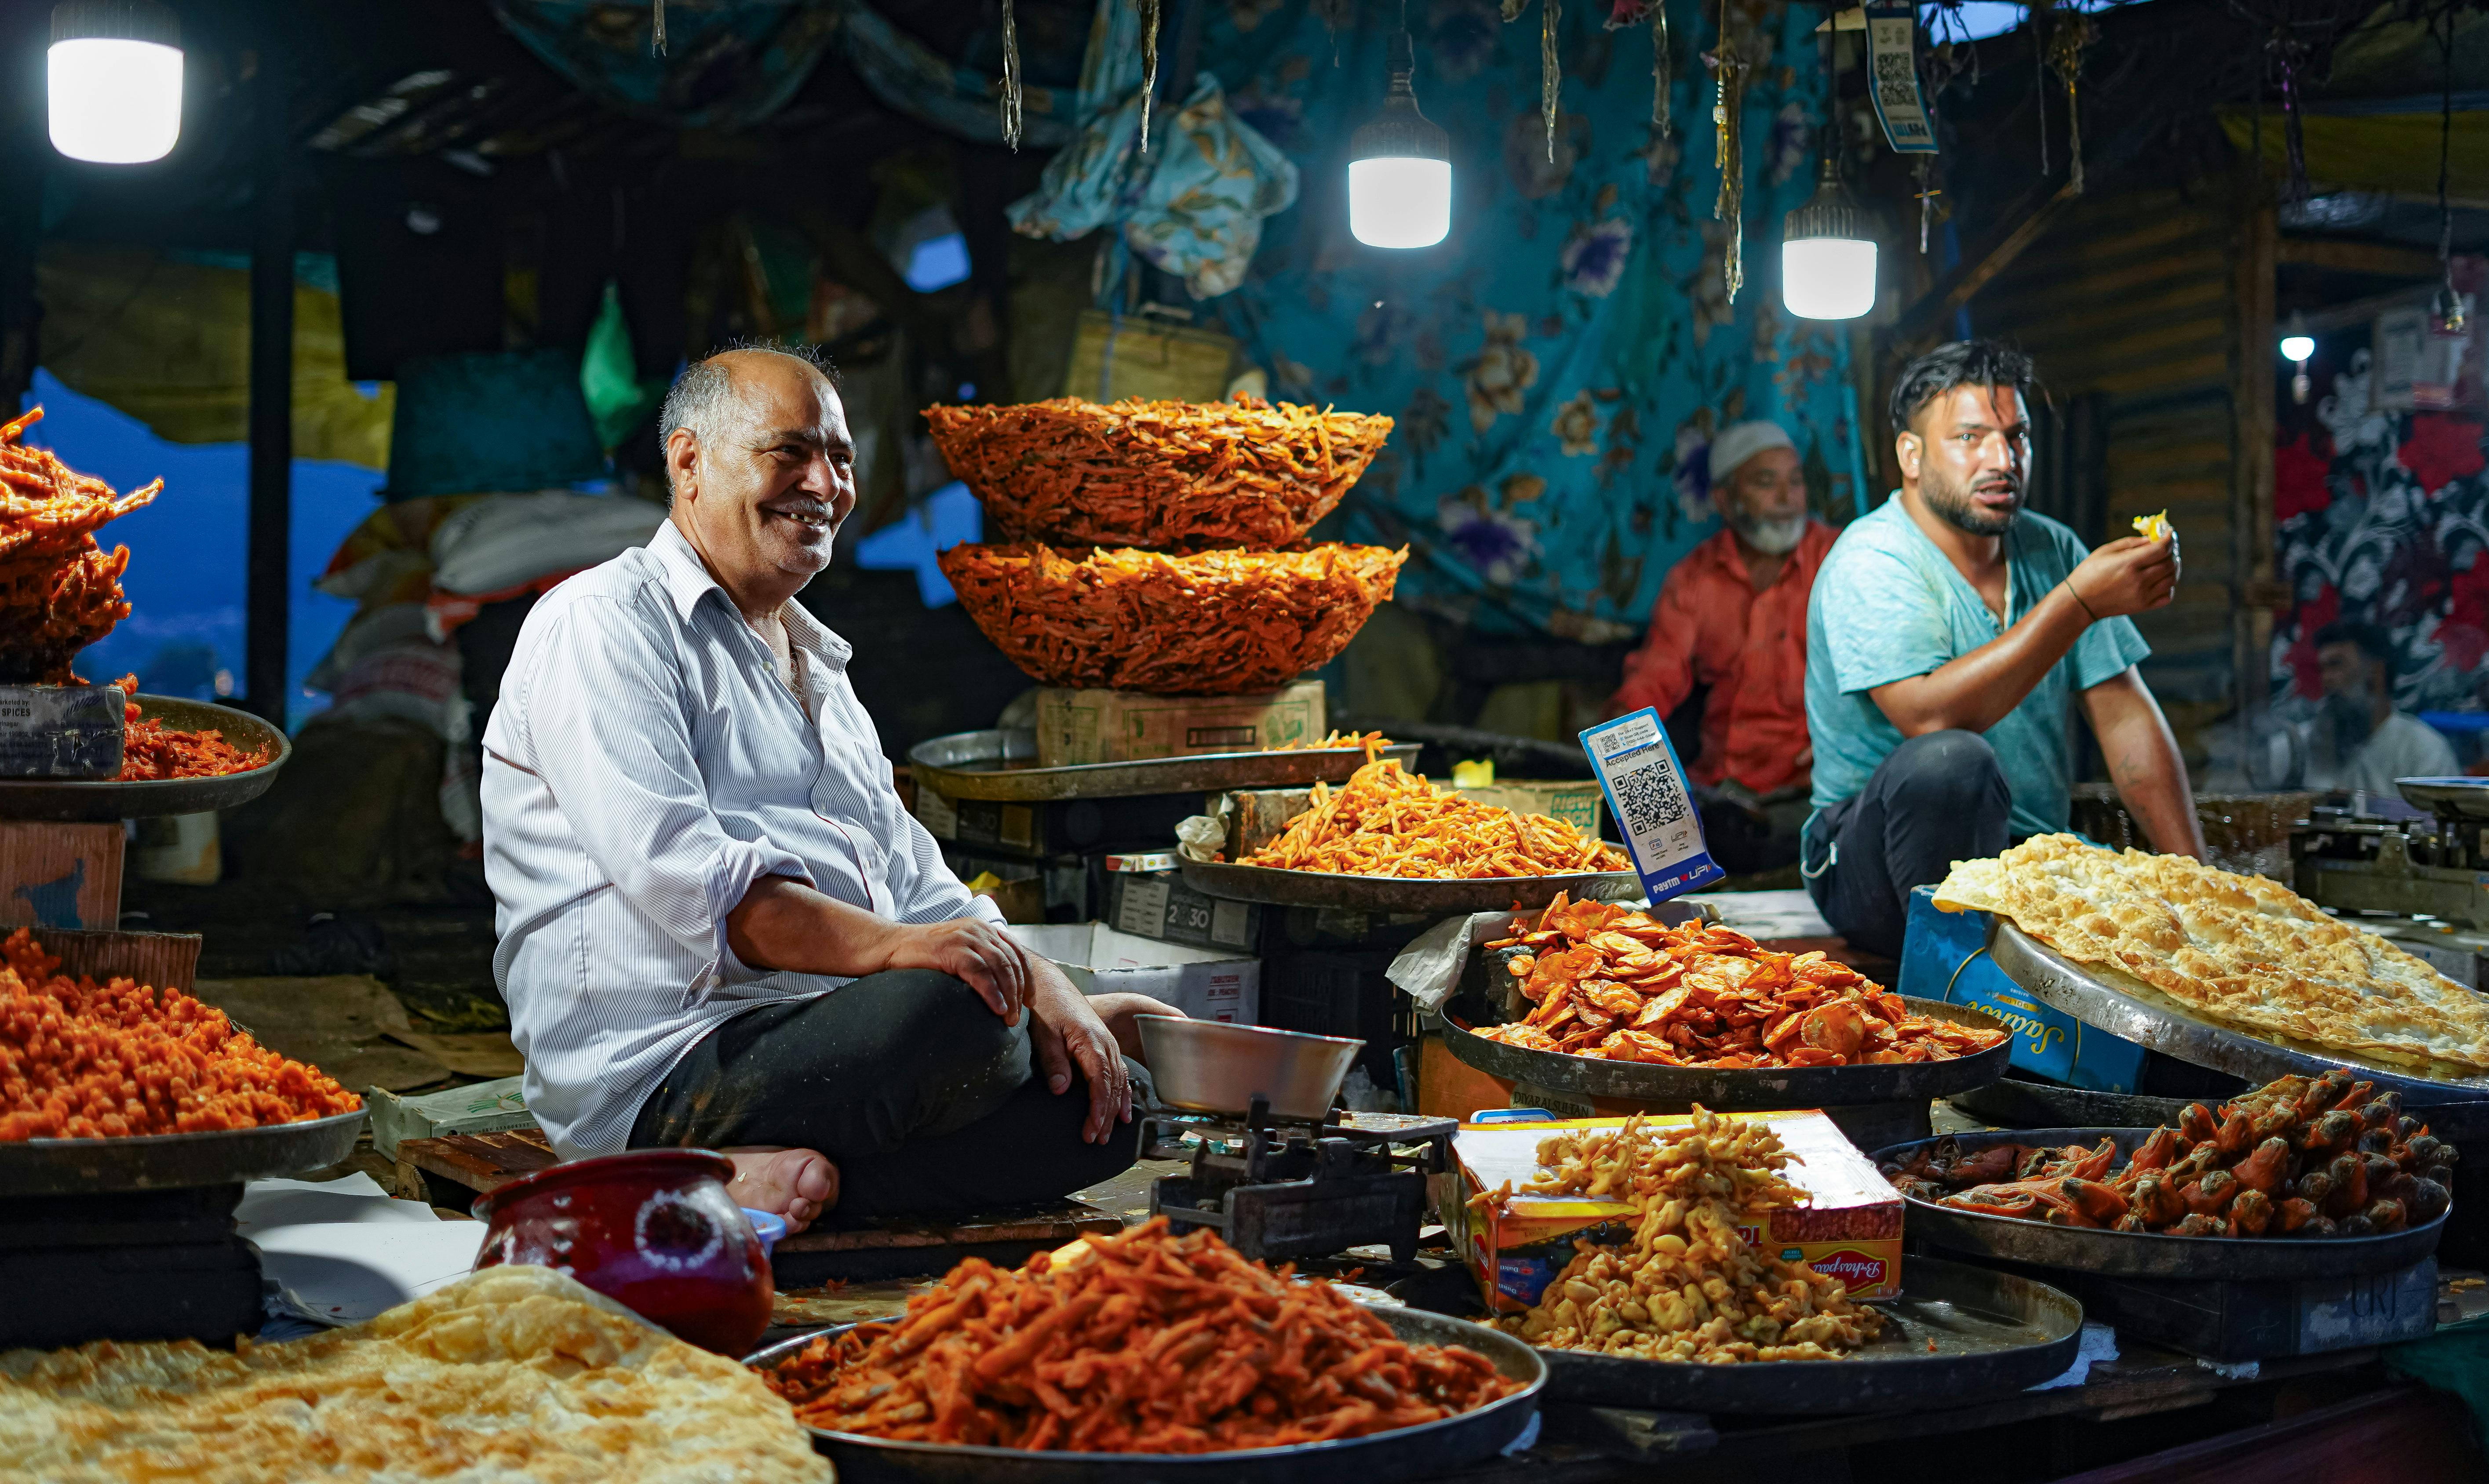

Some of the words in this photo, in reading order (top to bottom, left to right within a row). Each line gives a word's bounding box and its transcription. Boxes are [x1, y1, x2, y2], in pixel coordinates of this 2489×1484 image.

[2, 708, 31, 717] SPICES
[1606, 749, 1641, 767] Accepted
[1642, 743, 1660, 754] Here
